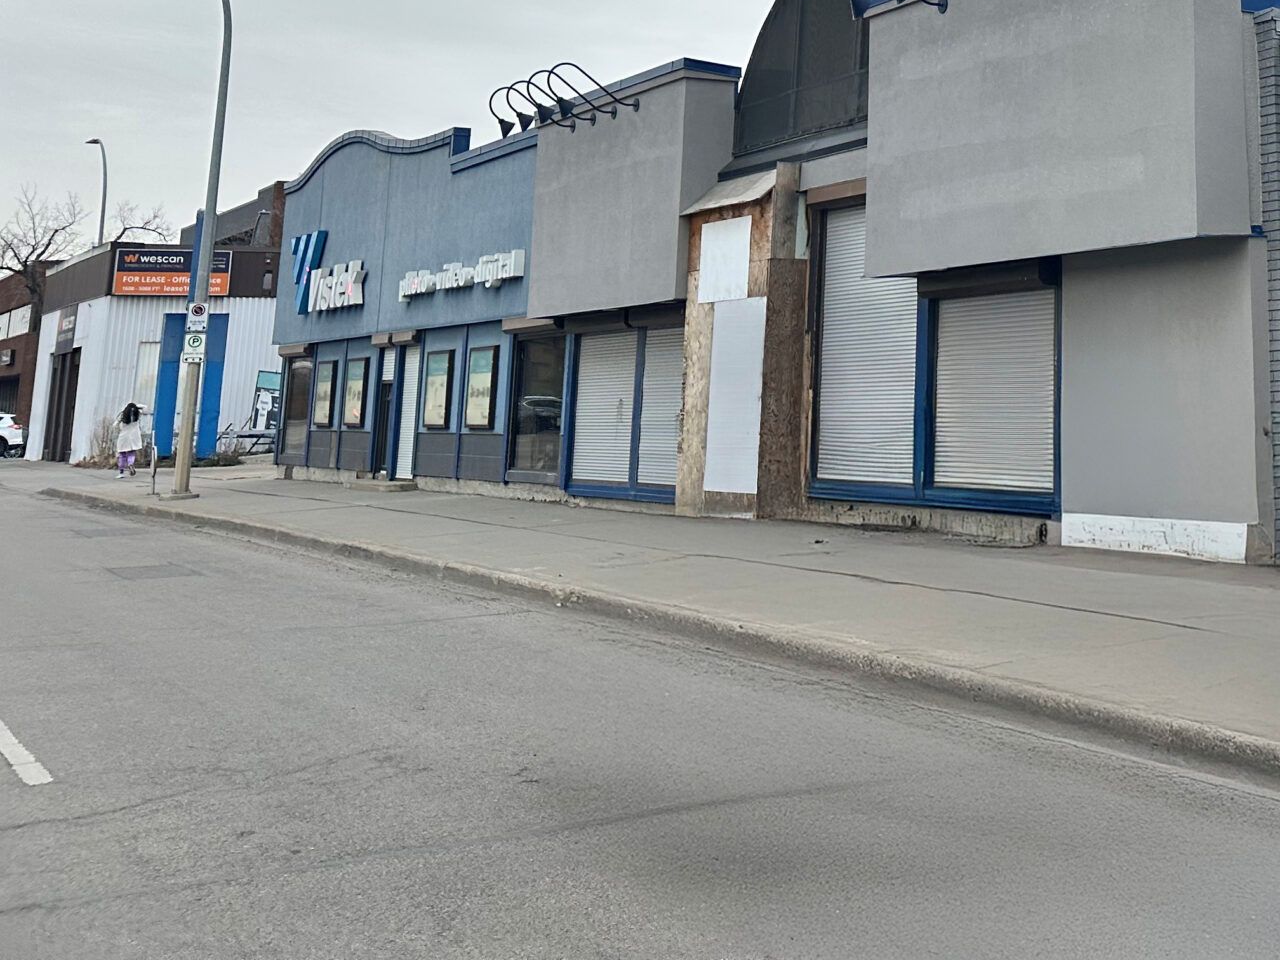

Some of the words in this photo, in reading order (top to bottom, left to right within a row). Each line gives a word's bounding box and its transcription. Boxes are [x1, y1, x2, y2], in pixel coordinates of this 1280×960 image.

[140, 255, 184, 263] wescan
[436, 262, 471, 290] video
[474, 249, 526, 289] digital
[172, 276, 190, 284] Offic
